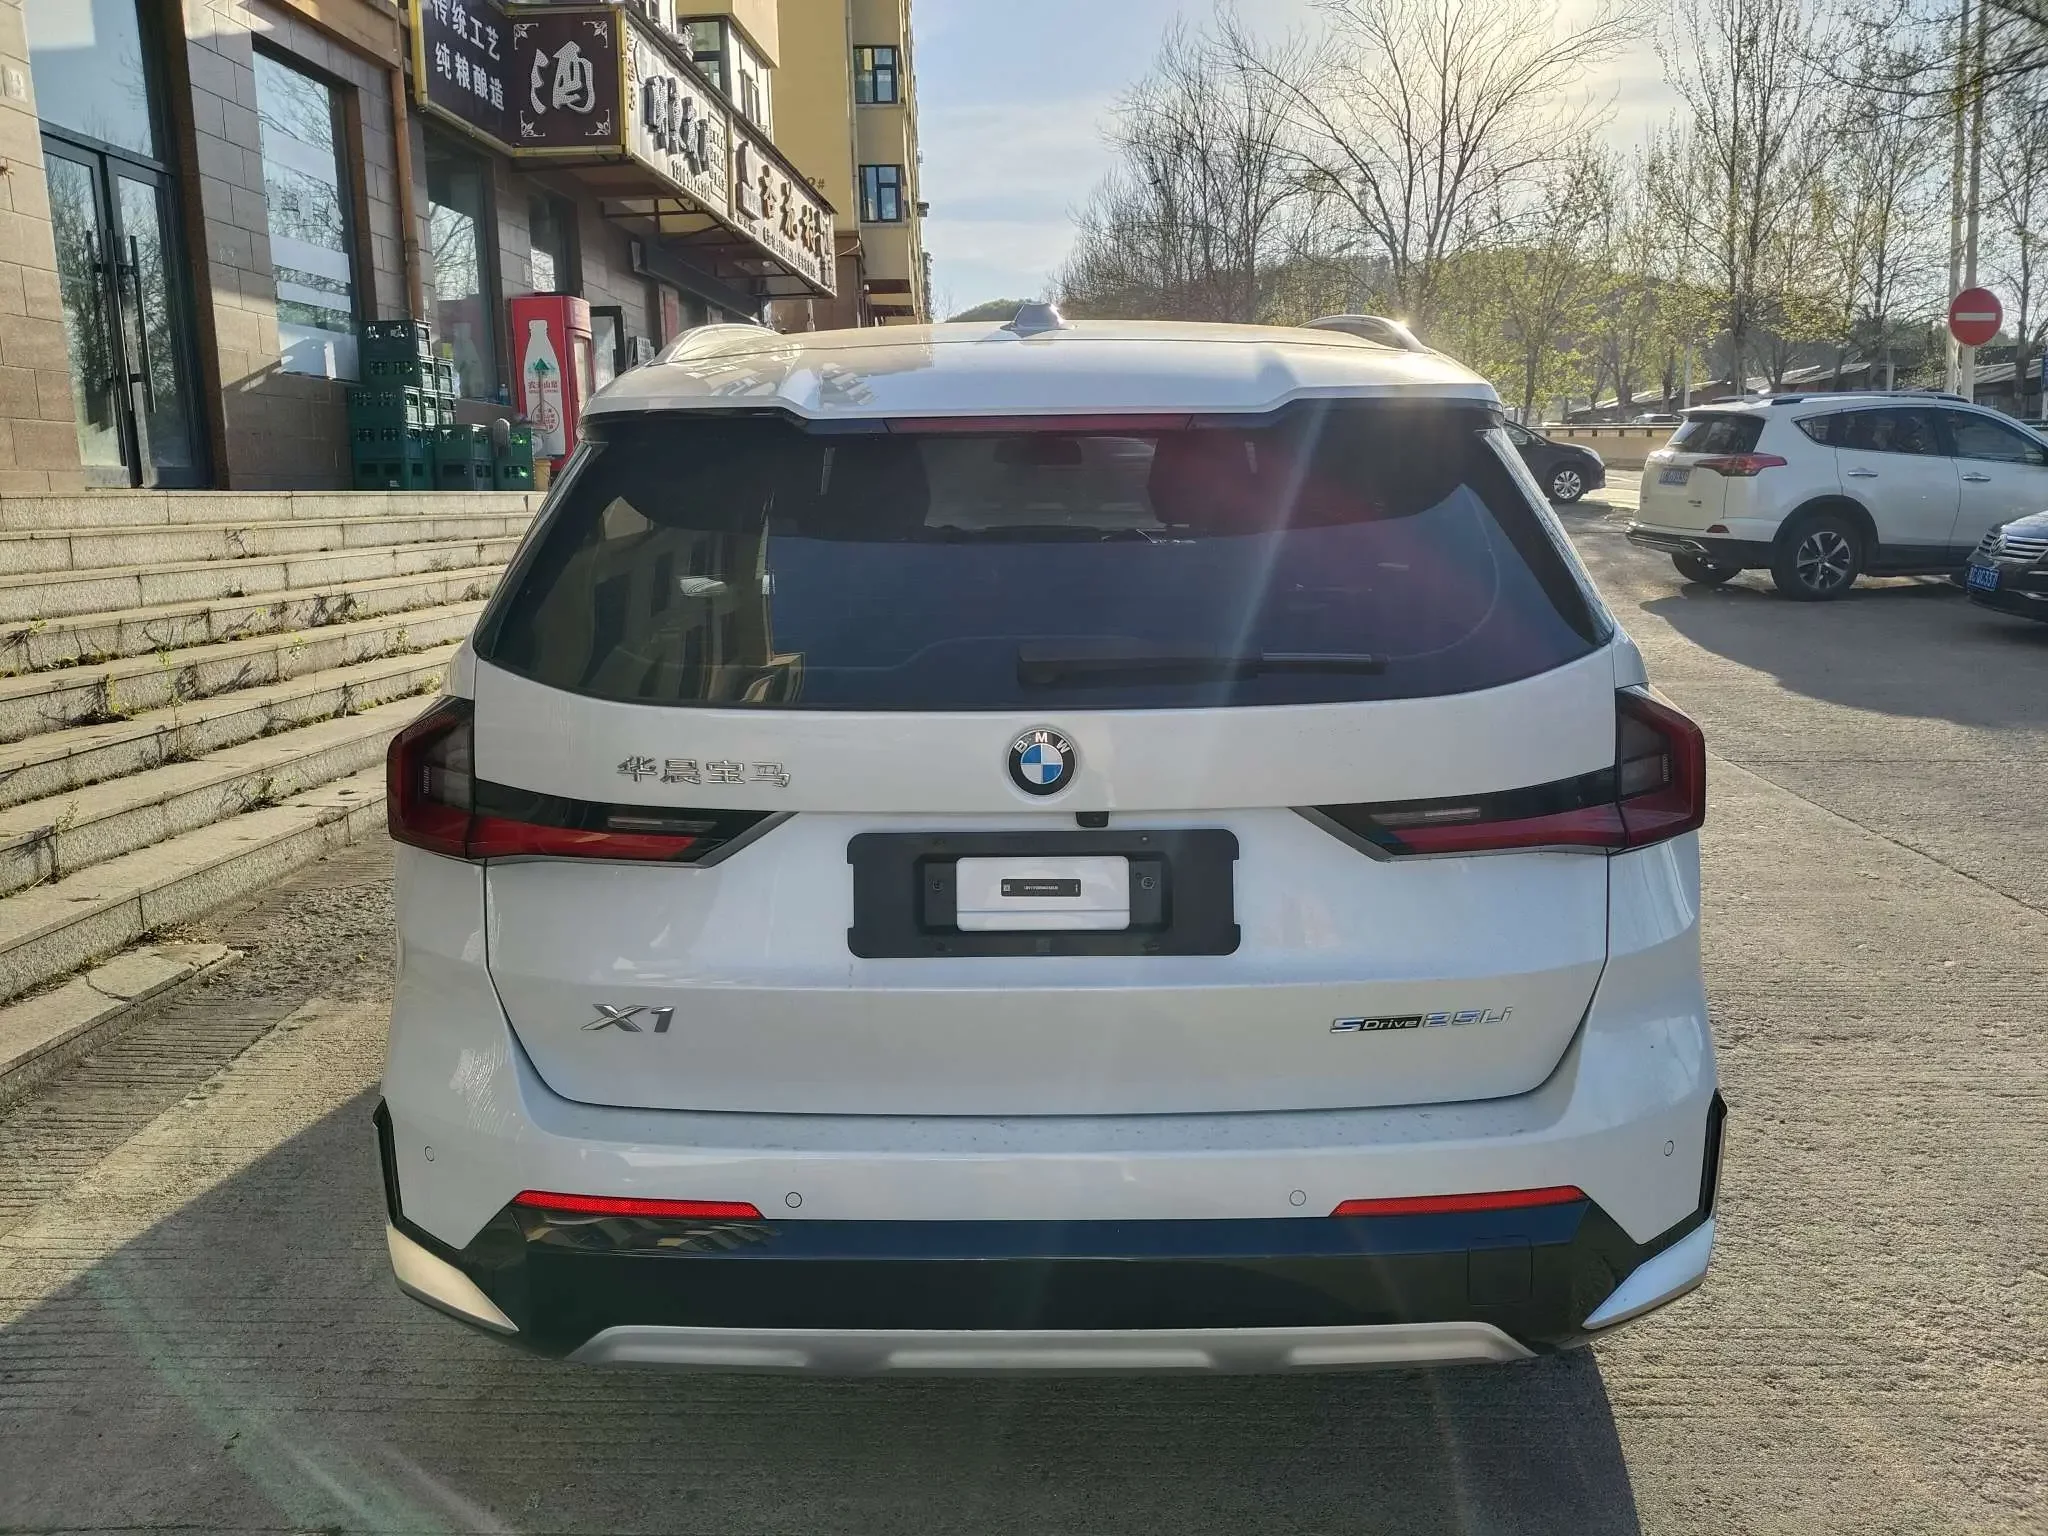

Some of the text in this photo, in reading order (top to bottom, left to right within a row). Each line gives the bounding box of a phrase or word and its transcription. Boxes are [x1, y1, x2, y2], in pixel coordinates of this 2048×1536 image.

[431, 0, 500, 61] 传统工艺
[435, 41, 505, 111] 纯粮酿造
[530, 40, 596, 114] 酒
[1014, 732, 1071, 754] BMW
[616, 755, 791, 788] 华晨宝马
[580, 1003, 676, 1034] X1
